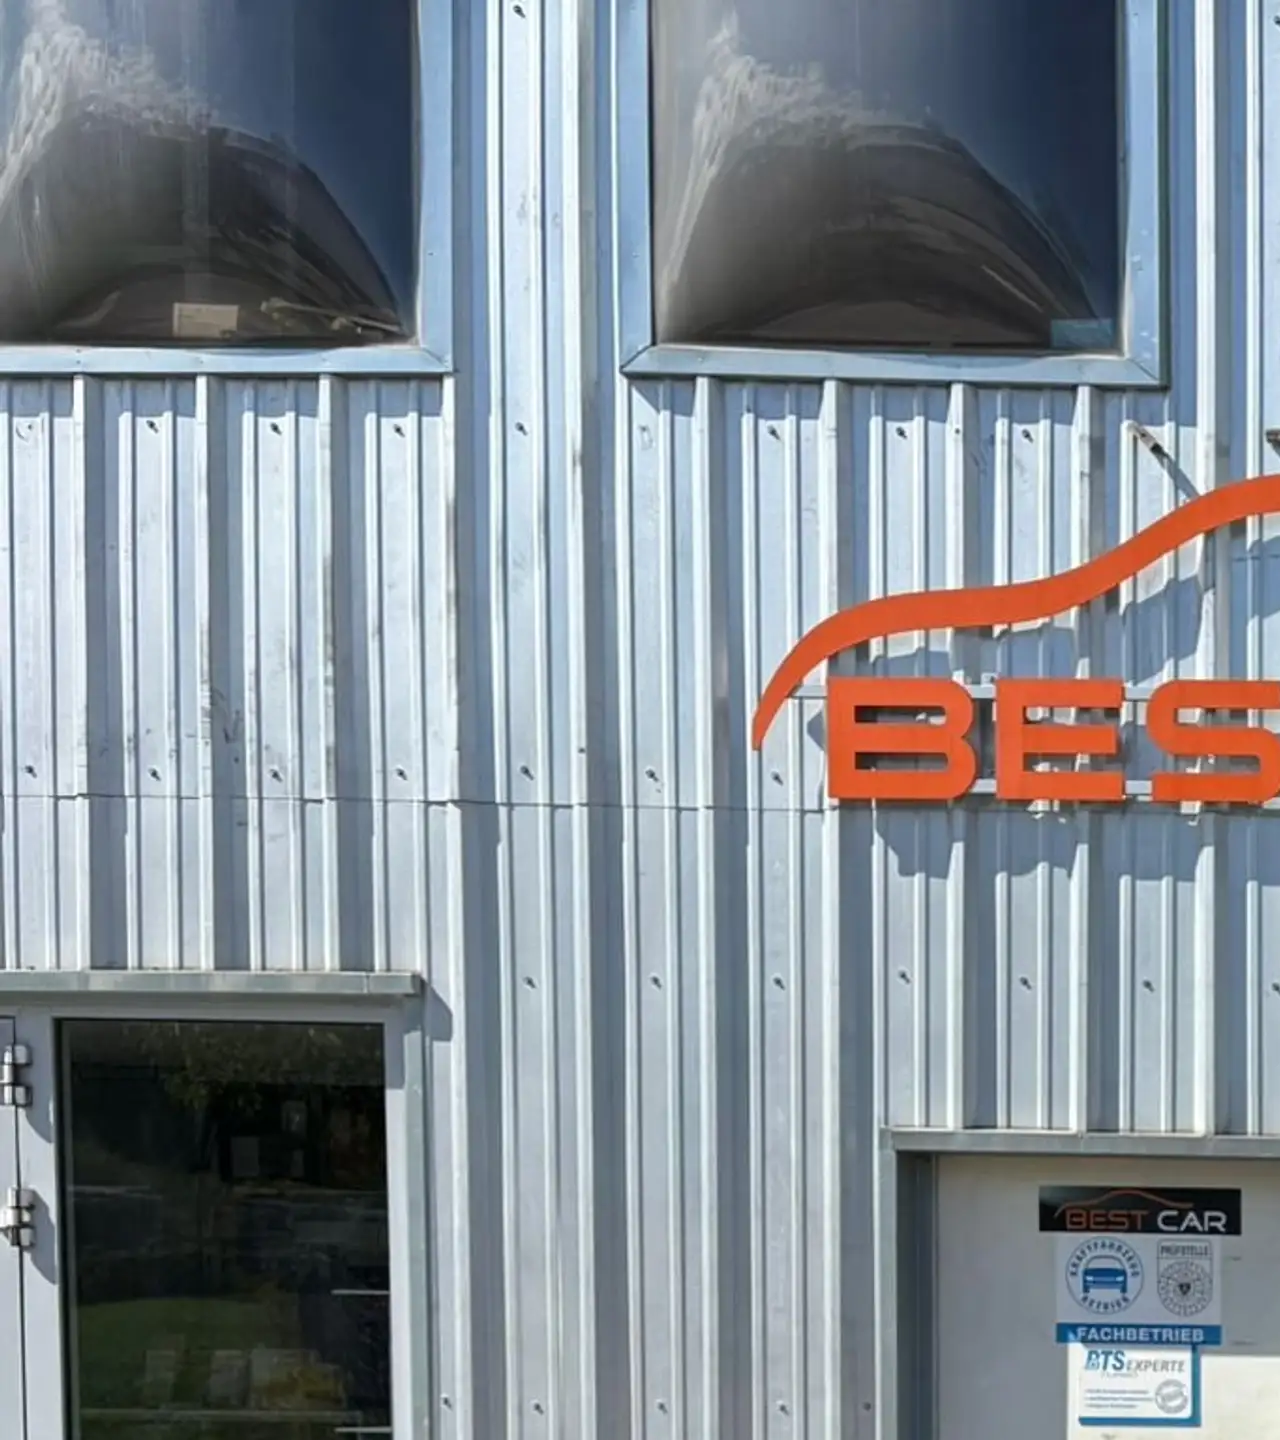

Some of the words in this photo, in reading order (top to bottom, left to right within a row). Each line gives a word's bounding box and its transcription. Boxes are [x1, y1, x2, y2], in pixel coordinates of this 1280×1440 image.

[1065, 1208, 1149, 1231] BEST
[1156, 1209, 1228, 1232] CAR
[1076, 1326, 1205, 1343] FACHBETRIEB
[1126, 1358, 1187, 1374] EXPERTE
